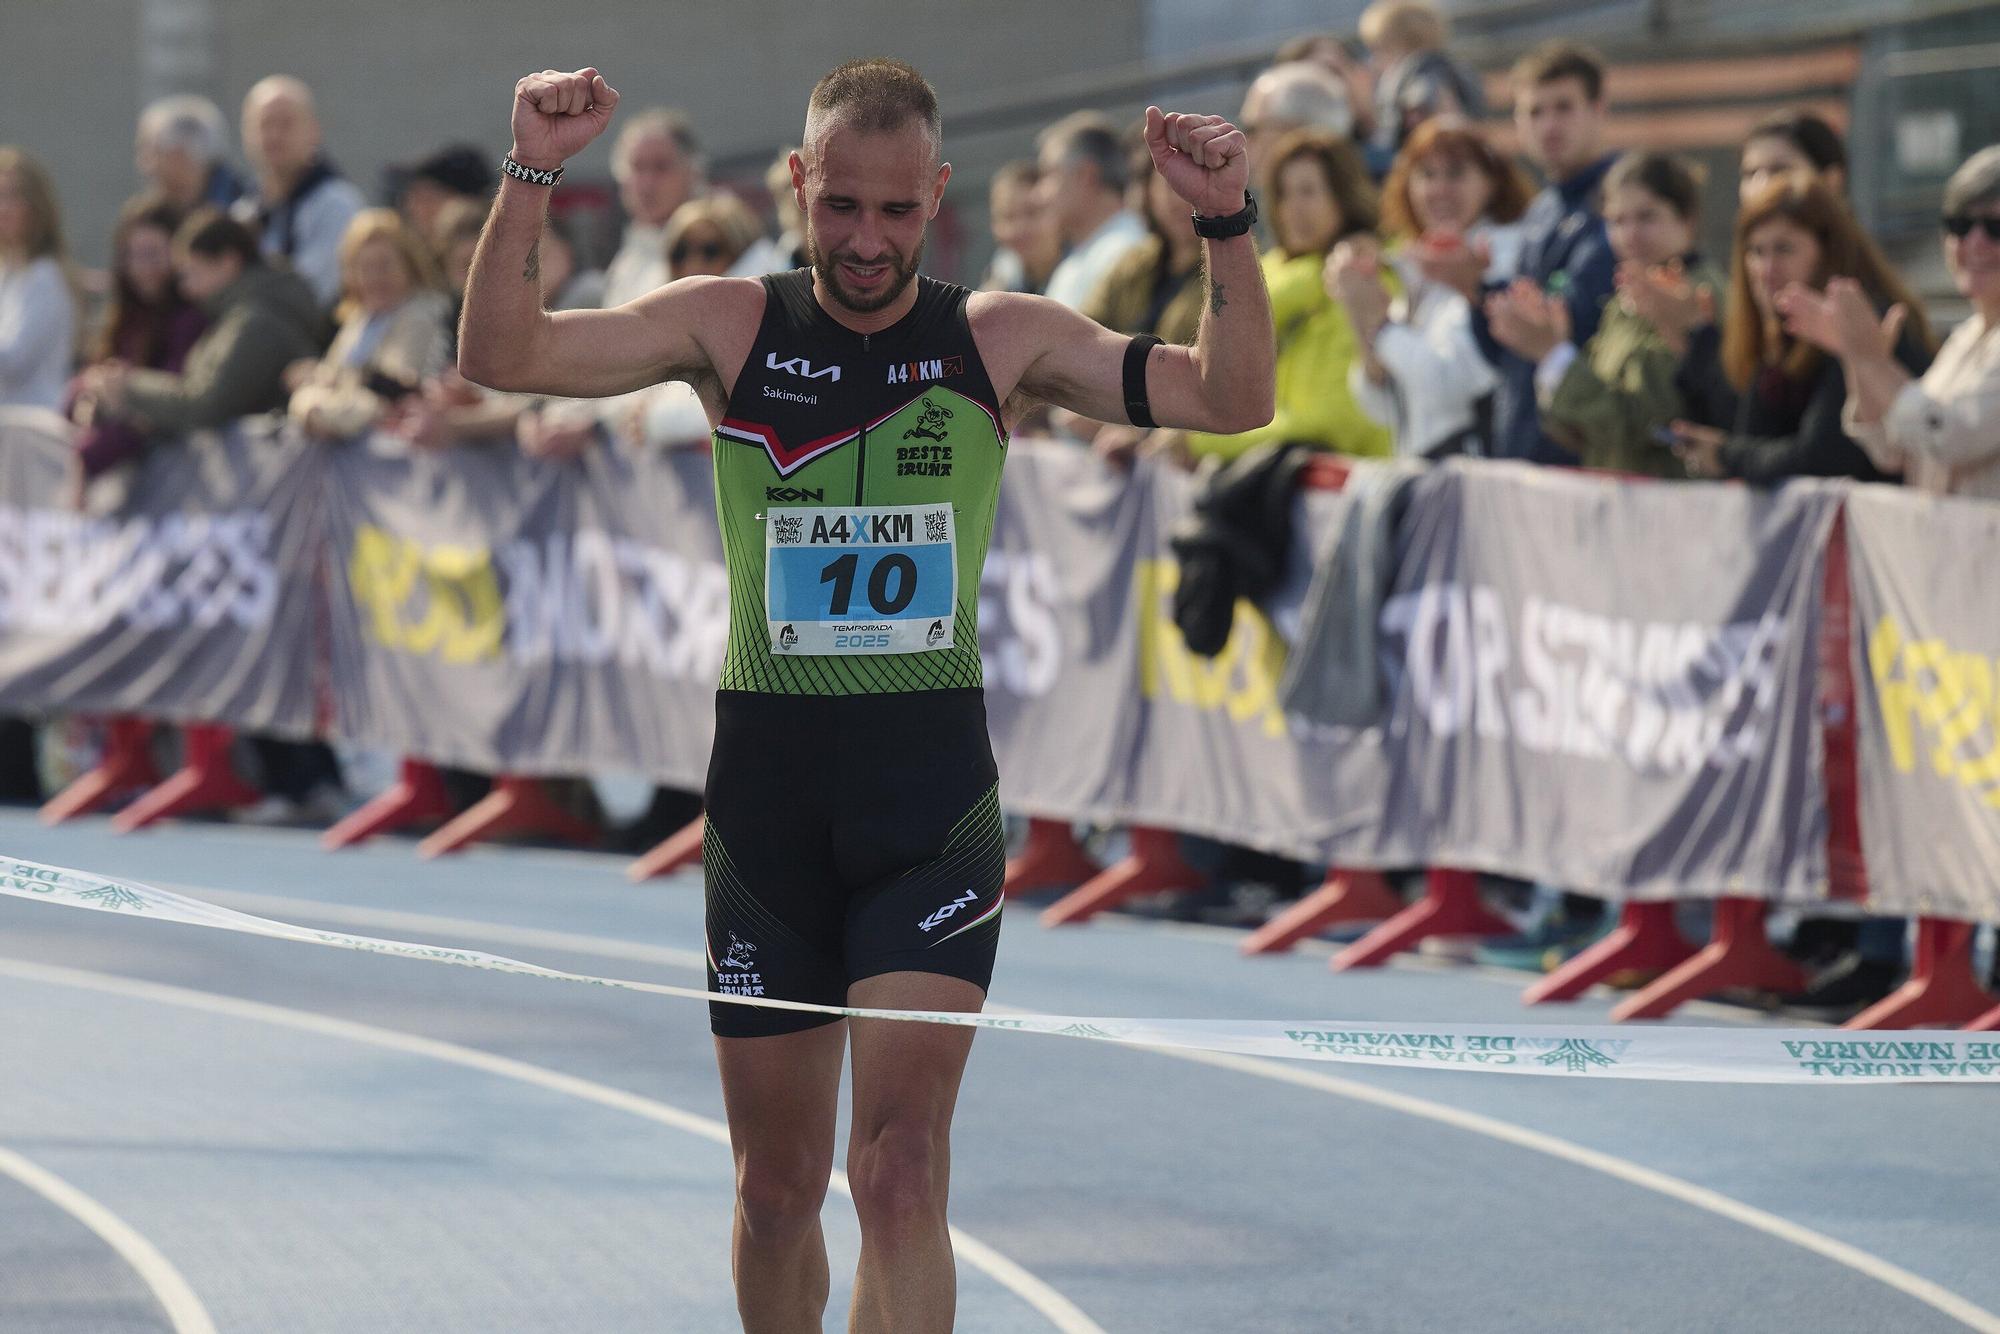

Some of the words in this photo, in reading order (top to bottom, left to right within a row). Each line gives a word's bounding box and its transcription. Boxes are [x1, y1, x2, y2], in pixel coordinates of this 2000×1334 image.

[887, 359, 943, 384] A4XKM
[763, 386, 817, 405] Sakimóvil
[897, 445, 952, 460] BESTE
[810, 514, 913, 544] A4XKM
[820, 553, 918, 615] 10
[835, 634, 890, 648] 2025
[12, 864, 62, 883] DE
[718, 973, 761, 984] BESTE
[1468, 1035, 1516, 1051] DE
[1781, 1040, 1955, 1060] NAVARRA
[1800, 1061, 1923, 1077] RURAL
